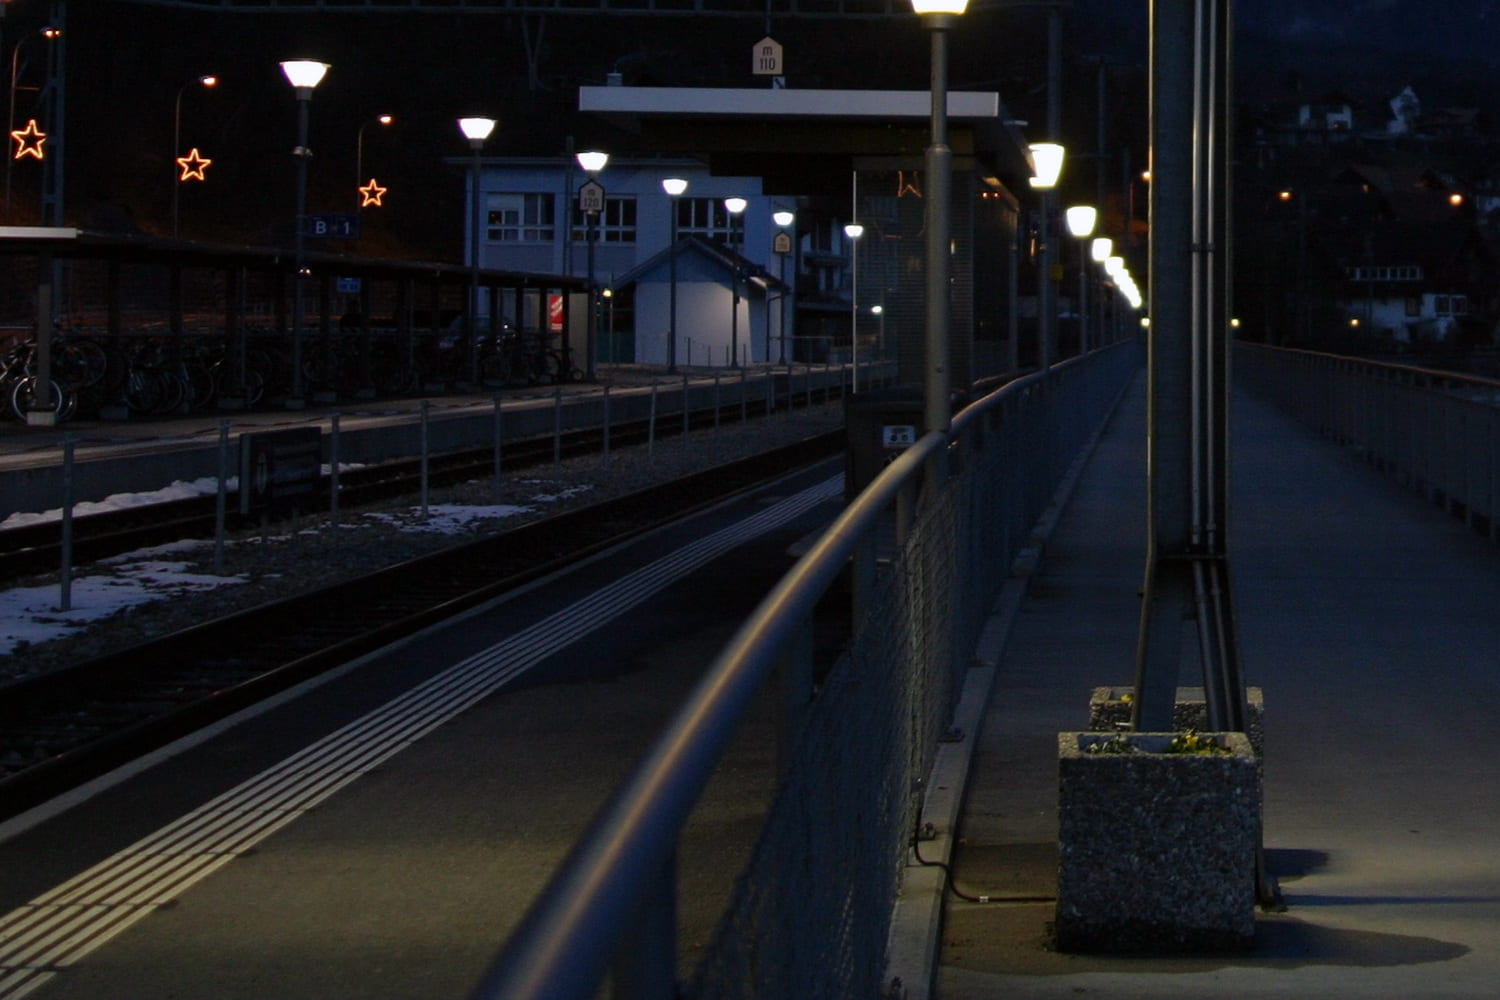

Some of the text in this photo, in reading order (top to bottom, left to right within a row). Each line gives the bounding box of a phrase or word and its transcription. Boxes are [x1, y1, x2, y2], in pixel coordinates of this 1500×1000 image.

[762, 46, 773, 56] m
[760, 58, 776, 70] 110
[315, 221, 327, 234] B
